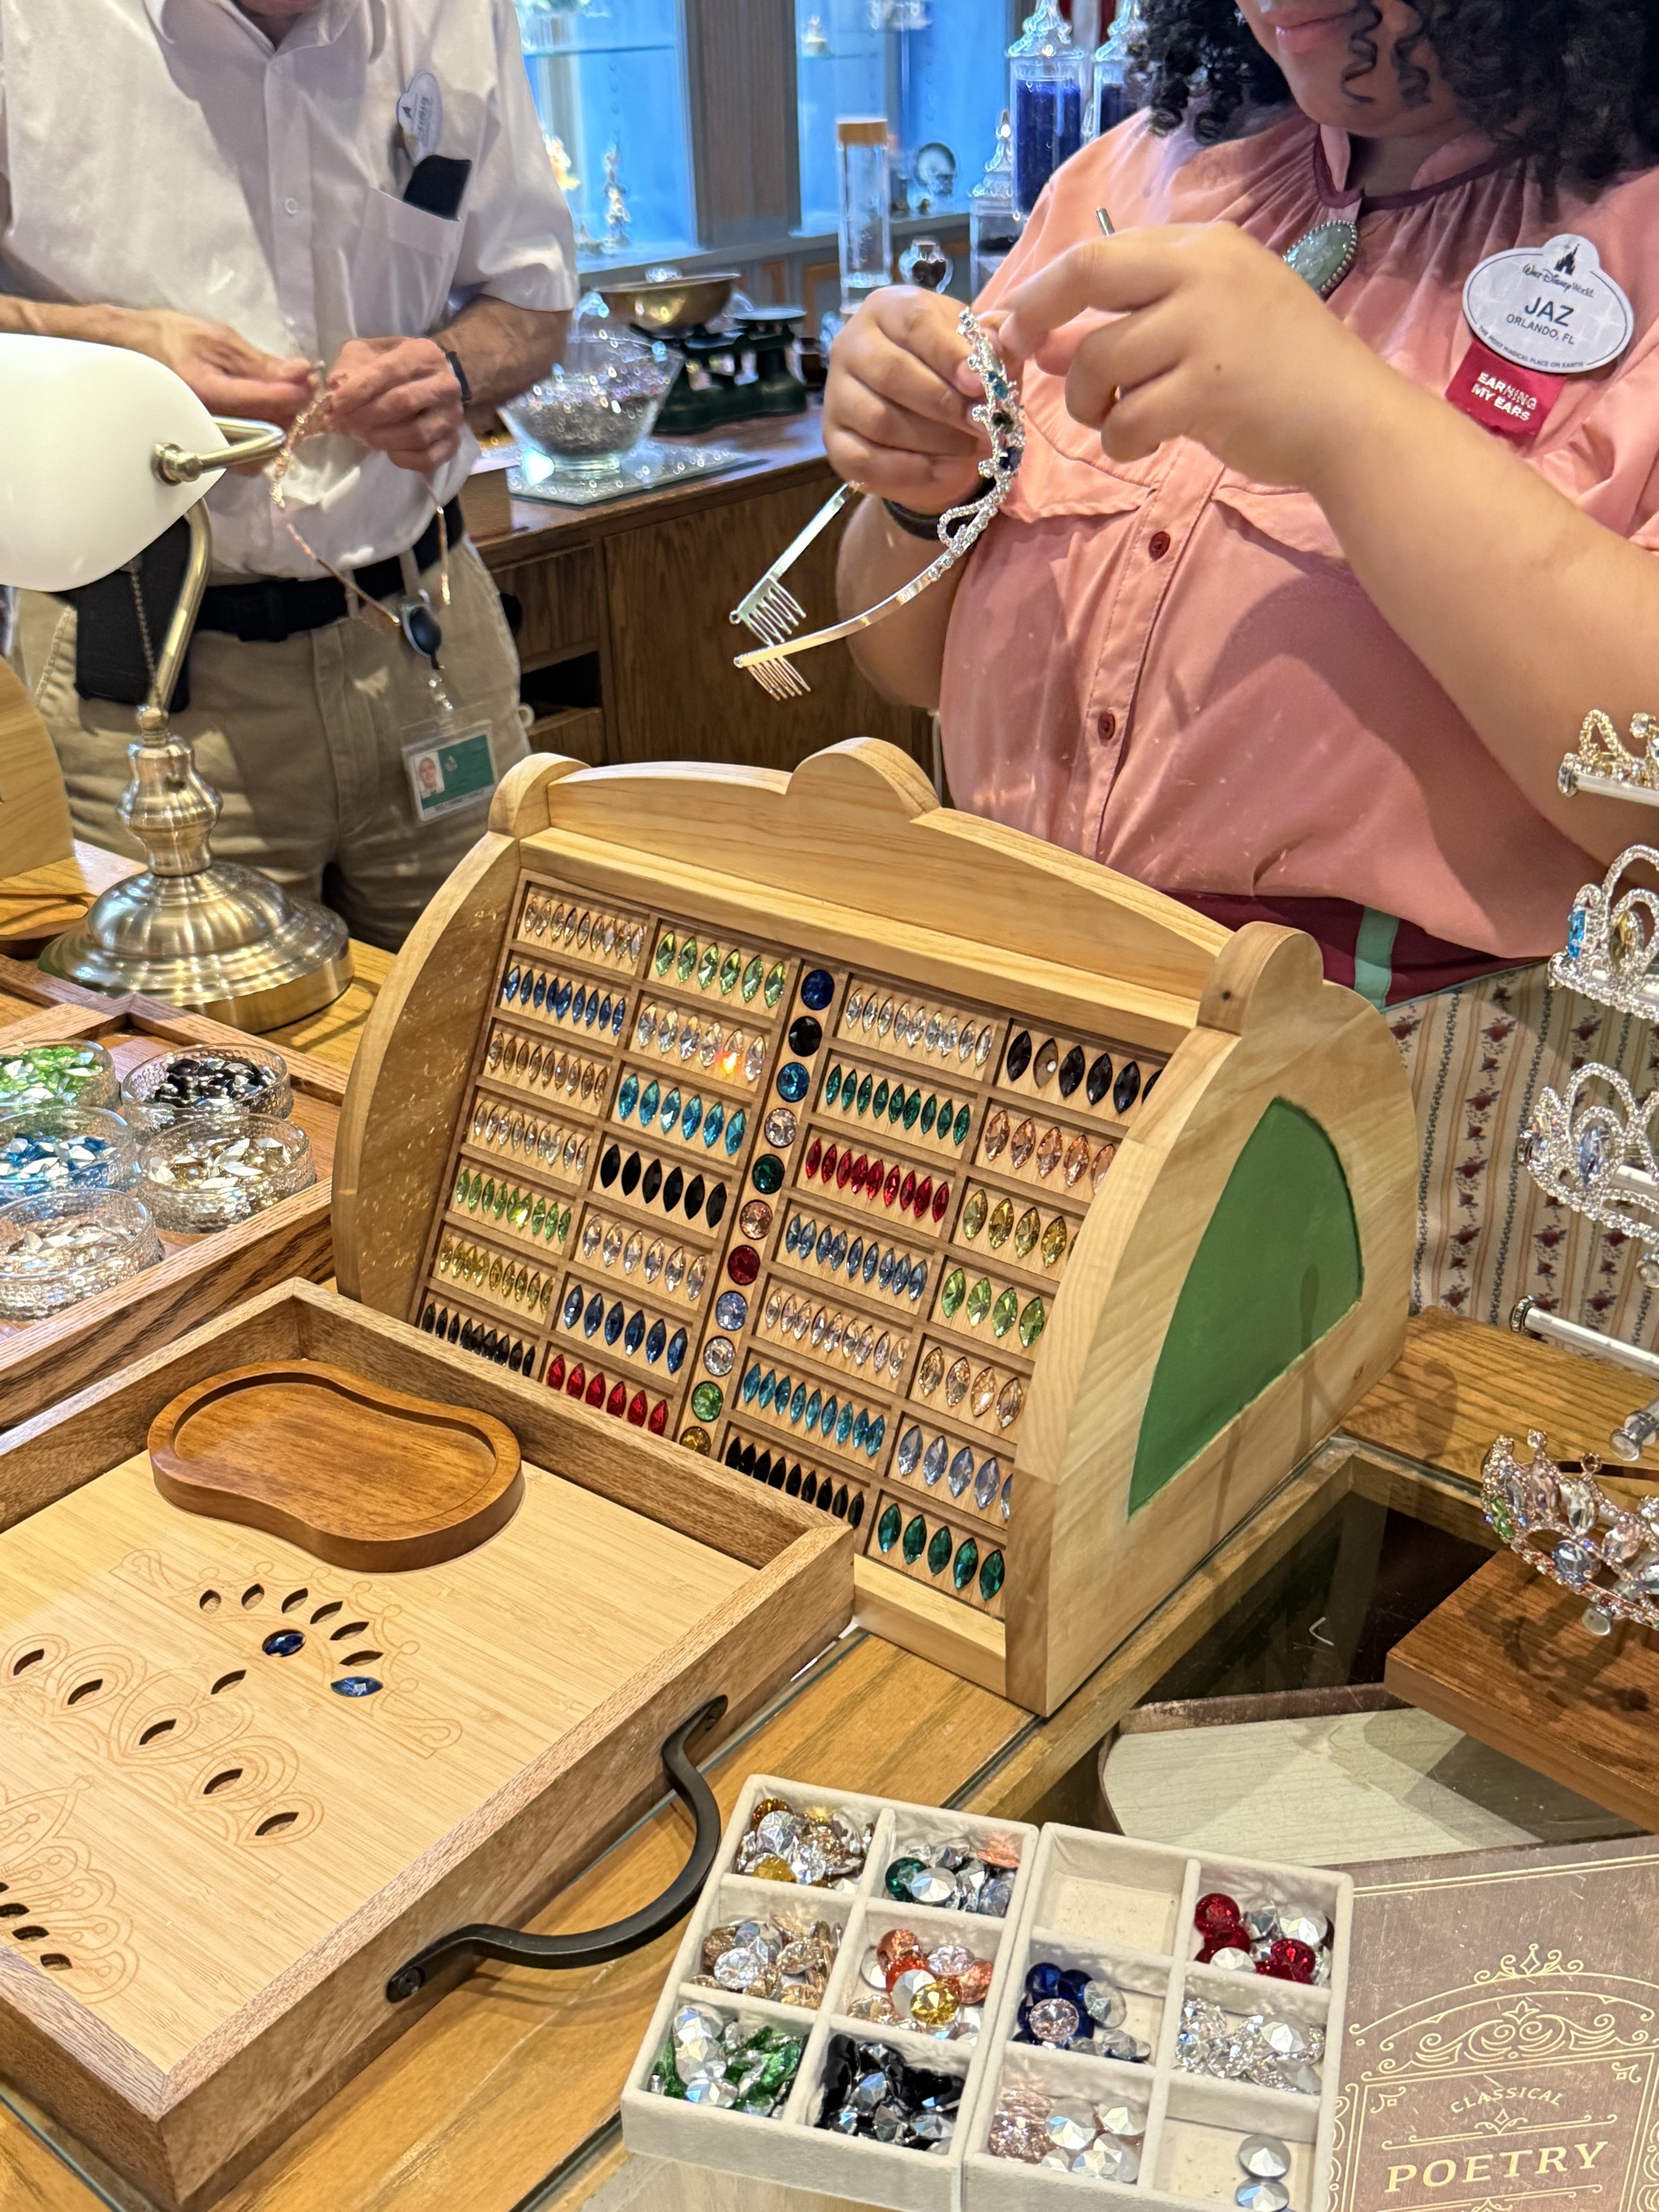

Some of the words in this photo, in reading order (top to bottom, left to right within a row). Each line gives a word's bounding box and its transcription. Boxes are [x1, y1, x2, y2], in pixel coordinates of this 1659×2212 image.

[1542, 268, 1572, 293] Disney
[1572, 283, 1593, 297] World
[1525, 297, 1574, 327] JAZ
[1507, 314, 1559, 340] ORLANDO,
[1562, 334, 1574, 344] FL
[1478, 326, 1488, 336] THE
[1503, 346, 1528, 361] MAGICAL
[1530, 357, 1549, 367] PLACE
[1471, 383, 1495, 401] MY
[1494, 396, 1530, 421] EARS
[1477, 372, 1537, 409] EARNING
[1451, 2087, 1565, 2113] CLASSICAL
[1384, 2141, 1608, 2193] POETRY
